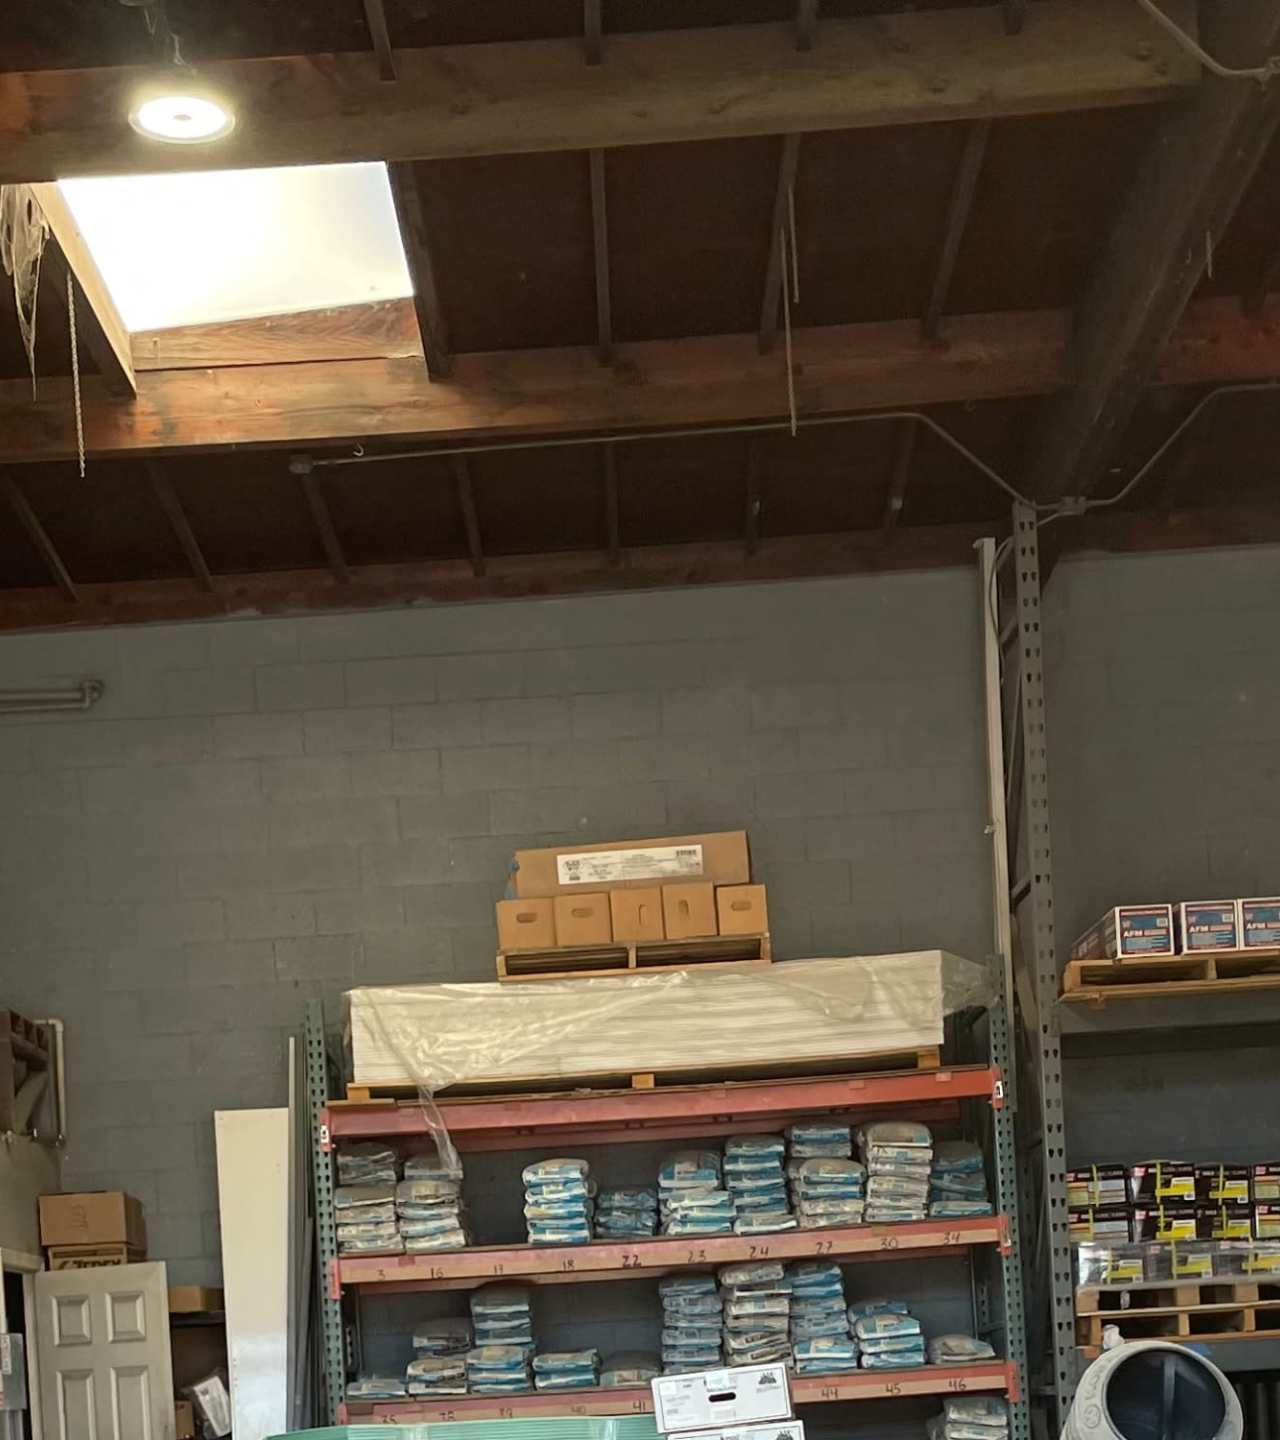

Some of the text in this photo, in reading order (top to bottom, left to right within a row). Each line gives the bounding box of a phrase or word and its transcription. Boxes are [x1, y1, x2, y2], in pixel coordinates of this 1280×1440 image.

[622, 1255, 642, 1268] 22
[749, 1247, 769, 1260] 24
[943, 1232, 962, 1246] 34
[632, 1399, 646, 1413] 41
[821, 1388, 839, 1400] 44
[885, 1383, 902, 1394] 45
[948, 1377, 967, 1391] 46
